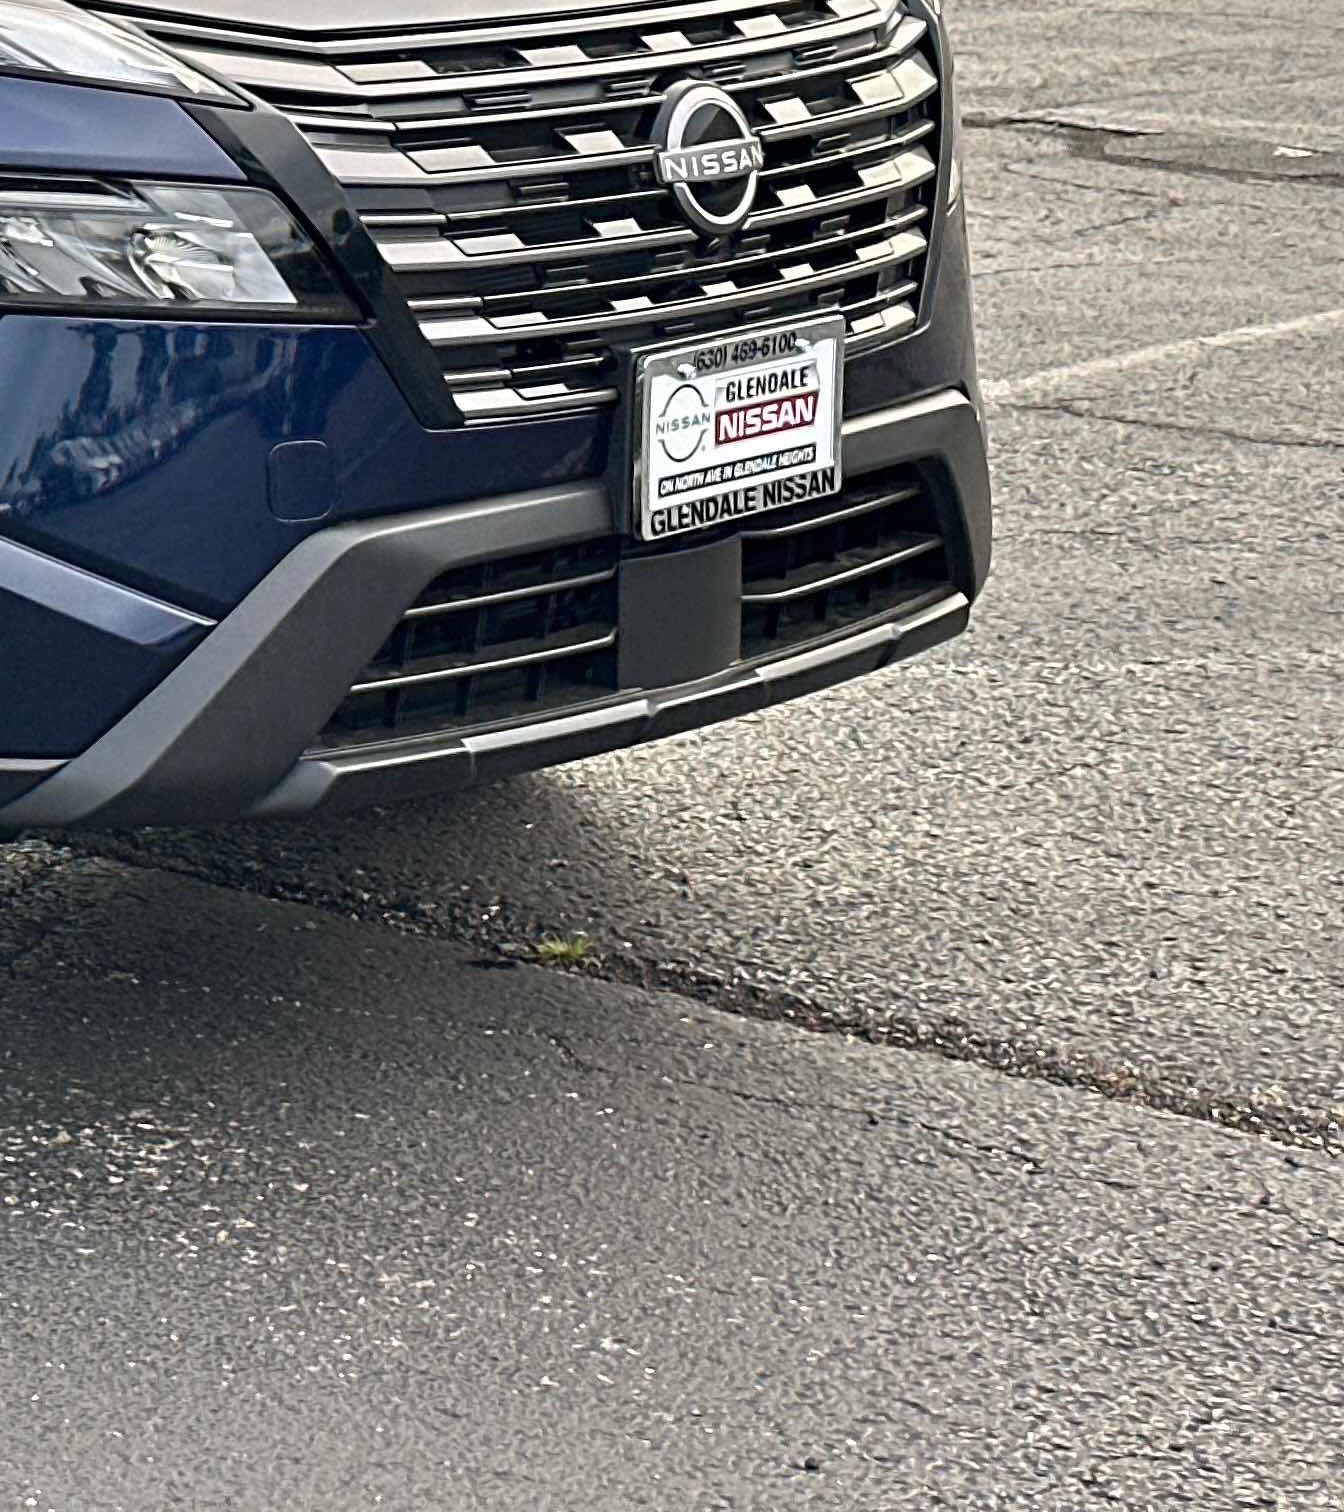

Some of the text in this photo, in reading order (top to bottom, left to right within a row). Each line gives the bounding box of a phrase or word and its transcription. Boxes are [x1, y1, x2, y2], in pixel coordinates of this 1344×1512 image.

[664, 144, 764, 179] NISSAN
[731, 332, 798, 364] 469-6100
[725, 366, 809, 403] GLENDALE
[655, 411, 712, 435] NISSAN
[718, 395, 815, 442] NISSAN
[704, 466, 723, 485] AVE
[650, 467, 836, 537] GLENDALE NISSAN
